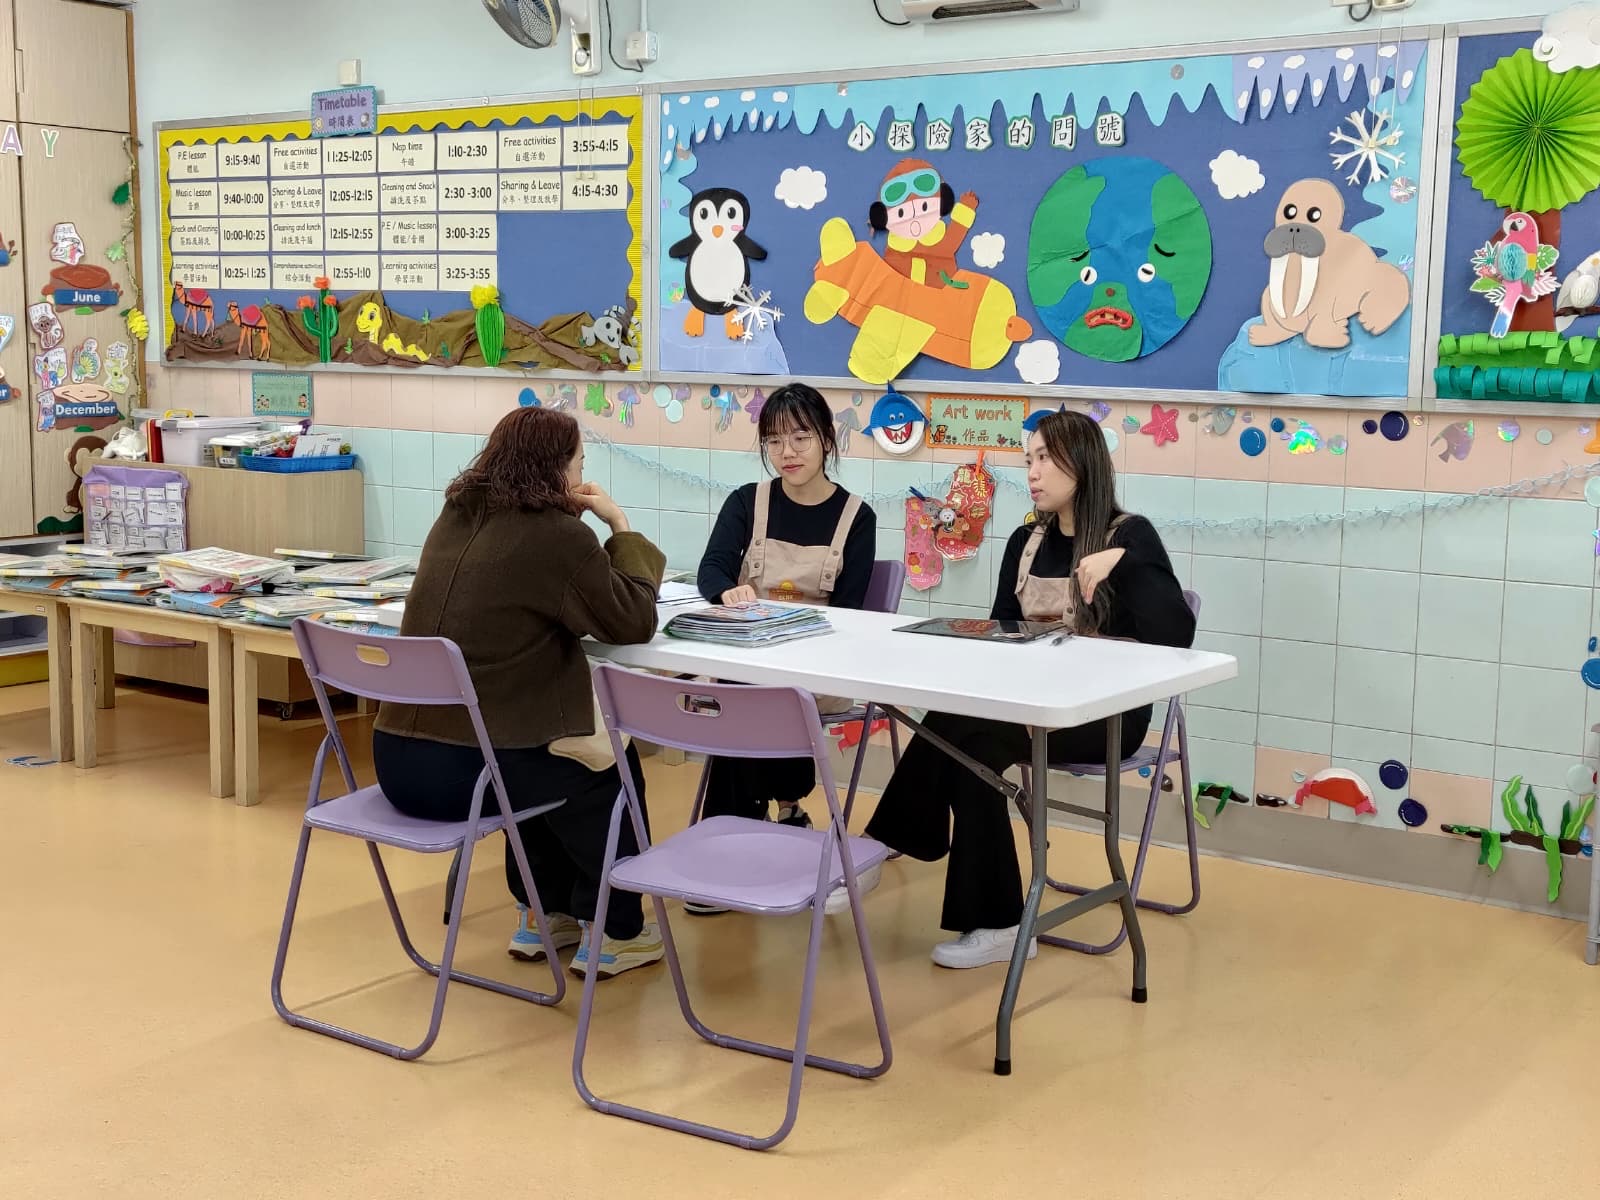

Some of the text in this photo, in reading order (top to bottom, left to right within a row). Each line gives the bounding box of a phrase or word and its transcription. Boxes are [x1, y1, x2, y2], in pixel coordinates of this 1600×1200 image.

[318, 94, 367, 111] Timetable
[852, 116, 1121, 147] 小探險家的問號
[392, 142, 423, 152] Nap time
[503, 136, 557, 148] Free activities
[572, 139, 619, 153] 3:55-4:15
[188, 151, 207, 160] lesson
[273, 147, 318, 157] Free activities
[447, 144, 488, 158] 1:10-2:30
[225, 154, 261, 166] 9:15-9:40
[272, 187, 322, 198] Sharing & Leave
[381, 181, 436, 192] Cleaning and Snack
[500, 180, 560, 193] Sharing & Leave
[571, 184, 618, 197] 4:15-4:30
[175, 189, 212, 197] Music lesson
[223, 192, 264, 204] 9:40-10:00
[329, 189, 373, 202] 12:05-12:15
[273, 223, 321, 234] Cleaning and lunch
[397, 221, 416, 231] Music
[416, 221, 437, 230] lesson
[223, 229, 266, 241] 10:00-10:25
[330, 228, 373, 240] 12:15-12:55
[445, 227, 490, 240] 3:00-3:25
[333, 266, 371, 279] 12:55-1:10
[381, 262, 437, 271] Learning activities
[445, 268, 490, 280] 3:25-3:55
[72, 291, 101, 302] June
[56, 404, 116, 415] December
[942, 404, 1013, 421] Art work
[962, 428, 990, 442] 作品
